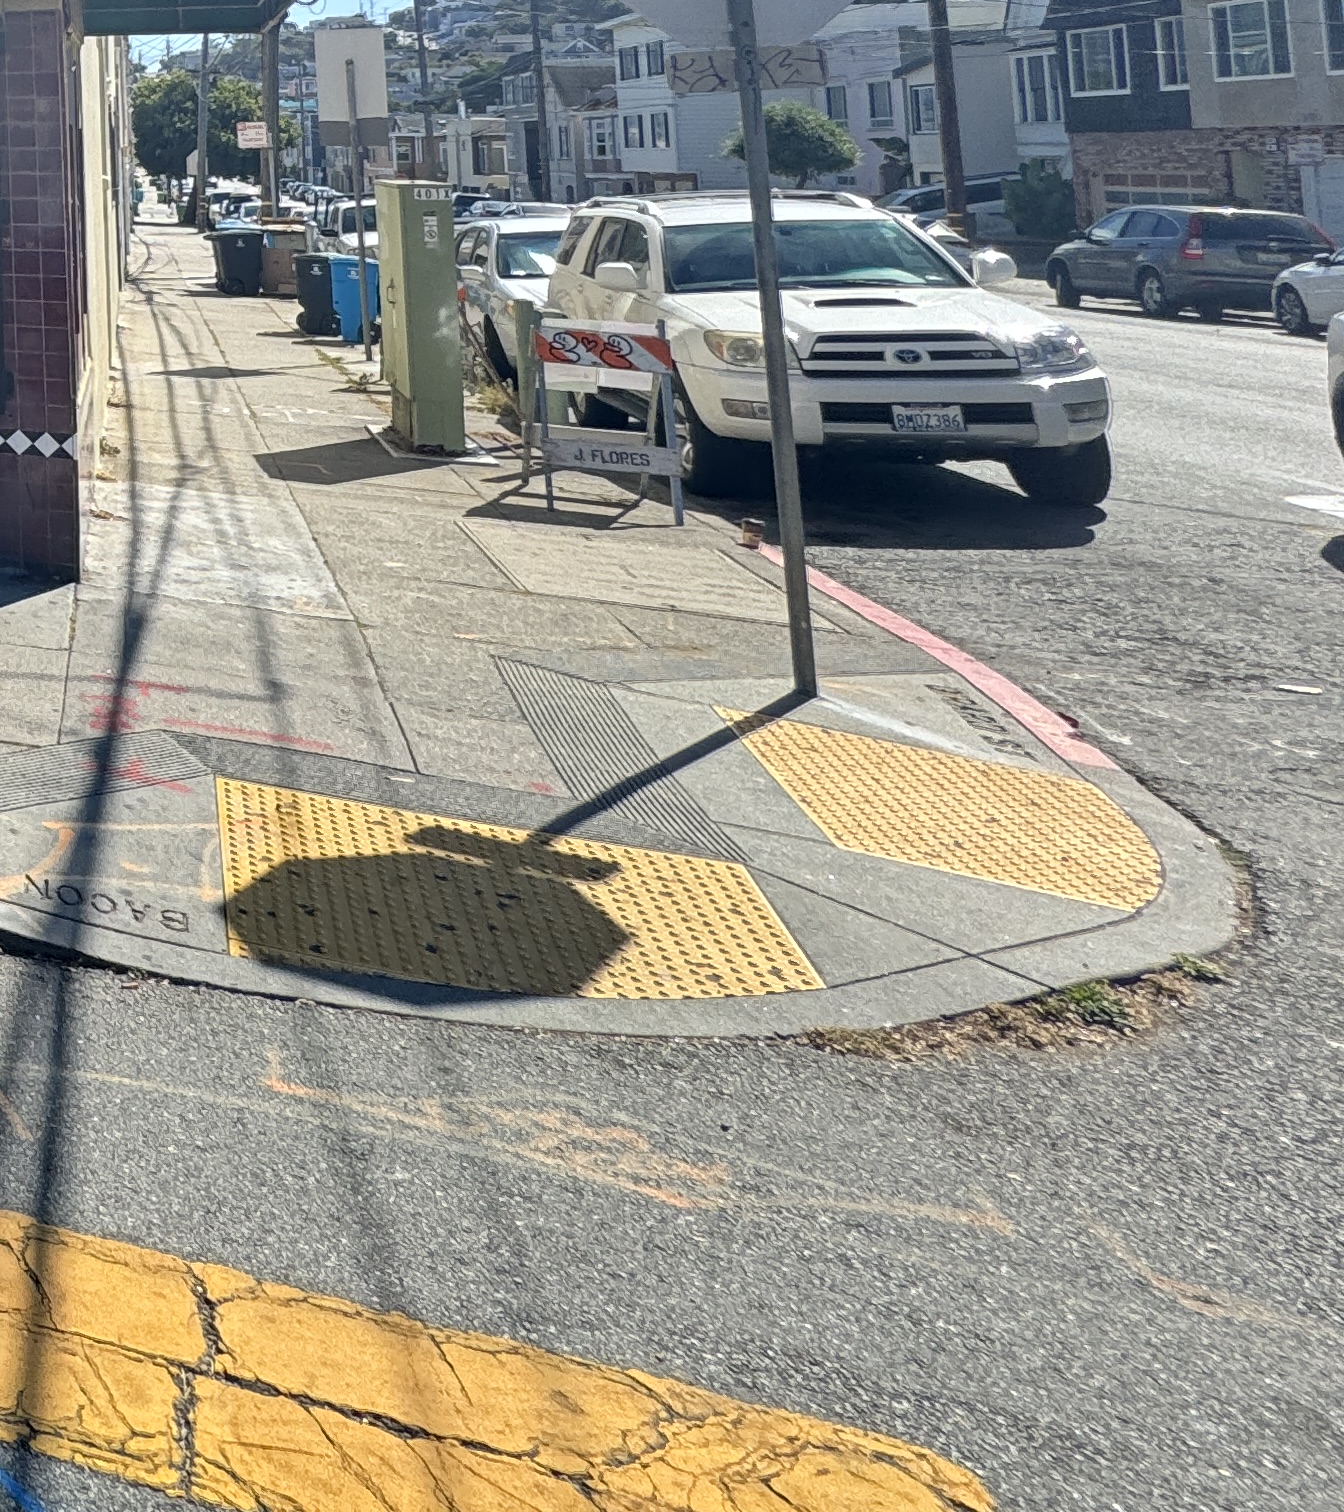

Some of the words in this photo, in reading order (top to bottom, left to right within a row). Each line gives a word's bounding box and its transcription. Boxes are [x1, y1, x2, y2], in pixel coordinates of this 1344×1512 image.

[416, 188, 450, 199] 401X
[574, 448, 587, 462] J.
[591, 449, 651, 467] FLORES
[25, 873, 190, 933] BACON
